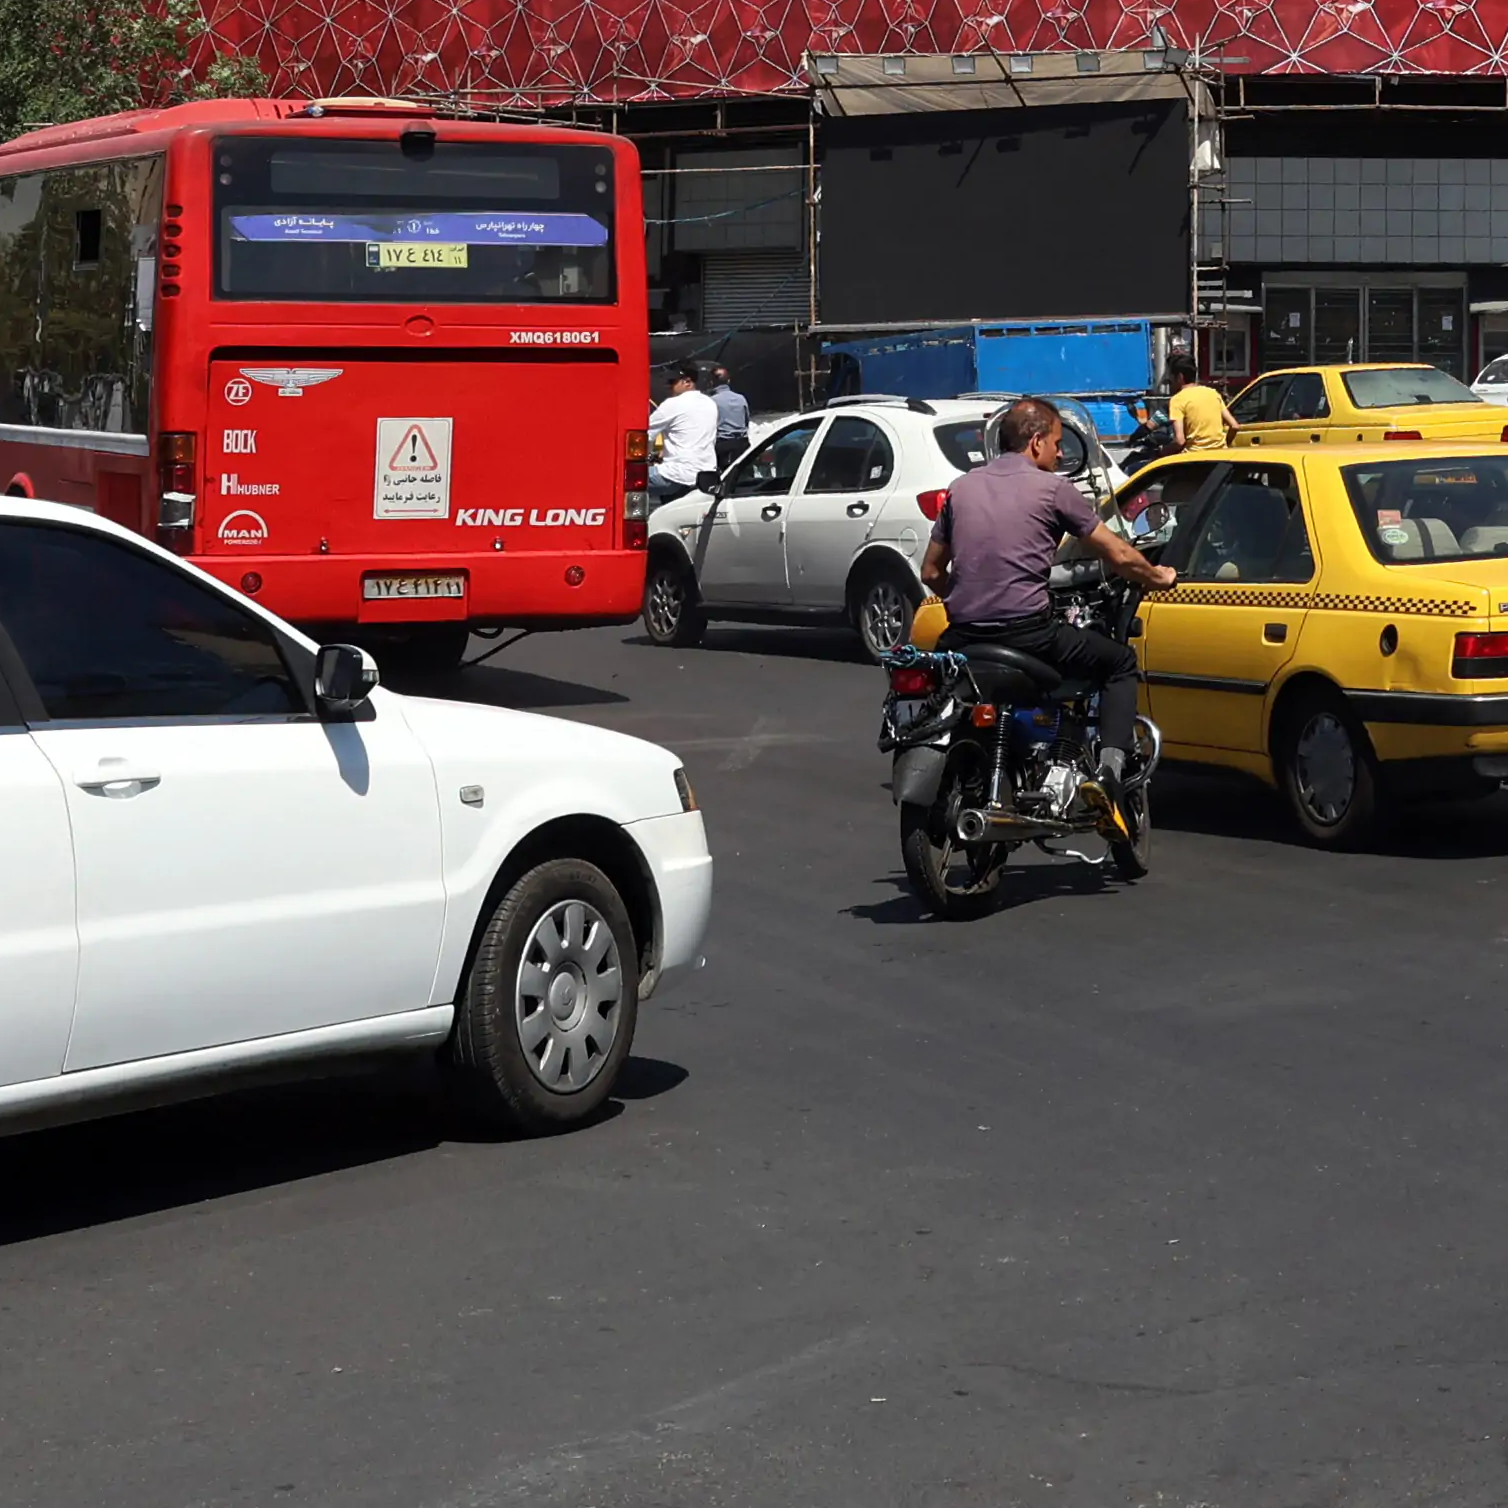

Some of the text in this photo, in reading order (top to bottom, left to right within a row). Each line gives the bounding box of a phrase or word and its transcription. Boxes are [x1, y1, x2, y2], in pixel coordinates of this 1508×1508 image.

[274, 216, 298, 227] آزادی
[510, 331, 600, 344] XMQ6180G1
[223, 429, 257, 454] BOCK
[393, 473, 417, 486] جانبی
[420, 473, 442, 483] فاصله
[237, 484, 280, 495] HUBNER
[416, 492, 441, 503] رعایت
[455, 508, 606, 526] KING LONG
[223, 529, 263, 538] MAN
